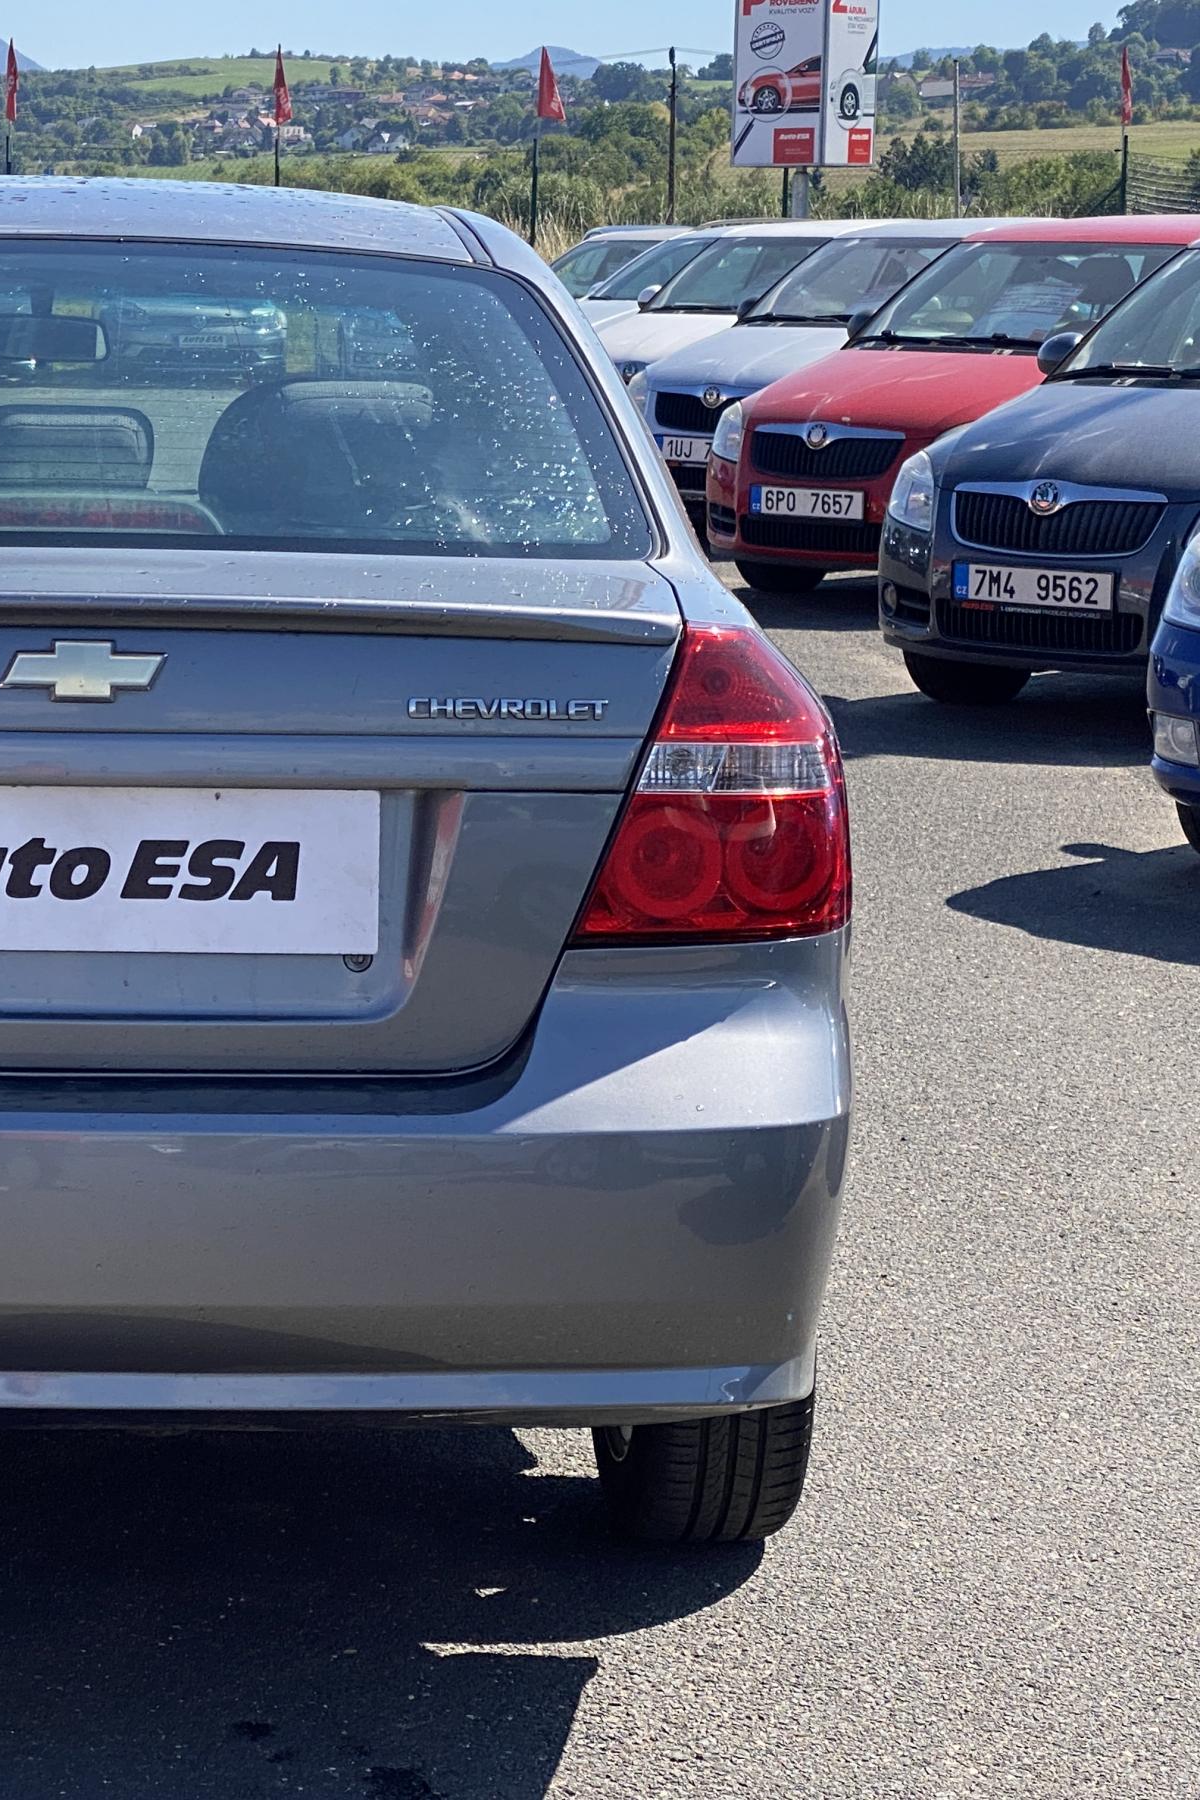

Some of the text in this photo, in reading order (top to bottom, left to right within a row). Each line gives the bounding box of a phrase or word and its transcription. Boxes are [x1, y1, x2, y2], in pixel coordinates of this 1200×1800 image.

[667, 439, 693, 458] 1UJ
[810, 492, 854, 515] 7657
[956, 569, 1099, 605] CZ 7M4 9562
[407, 697, 609, 721] CHEVROLET
[120, 840, 301, 901] ESA
